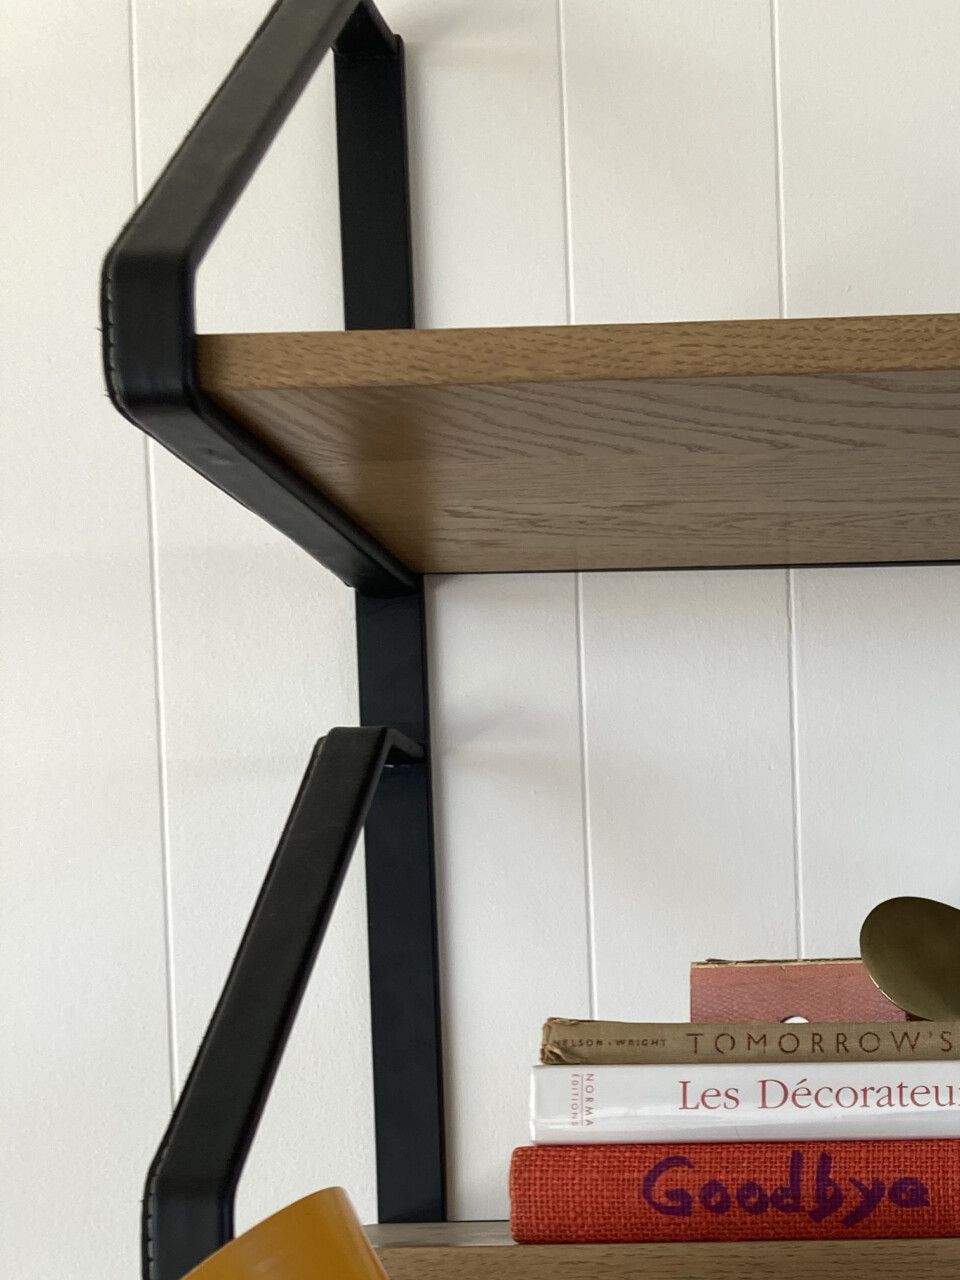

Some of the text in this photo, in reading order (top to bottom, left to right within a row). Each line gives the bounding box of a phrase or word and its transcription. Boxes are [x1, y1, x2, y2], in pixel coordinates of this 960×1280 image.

[615, 1038, 667, 1047] WRIGHT
[686, 1028, 952, 1054] TOMORROW'S
[585, 1073, 595, 1126] NORMA
[678, 1080, 740, 1109] Les
[642, 1150, 931, 1227] Goodbye
